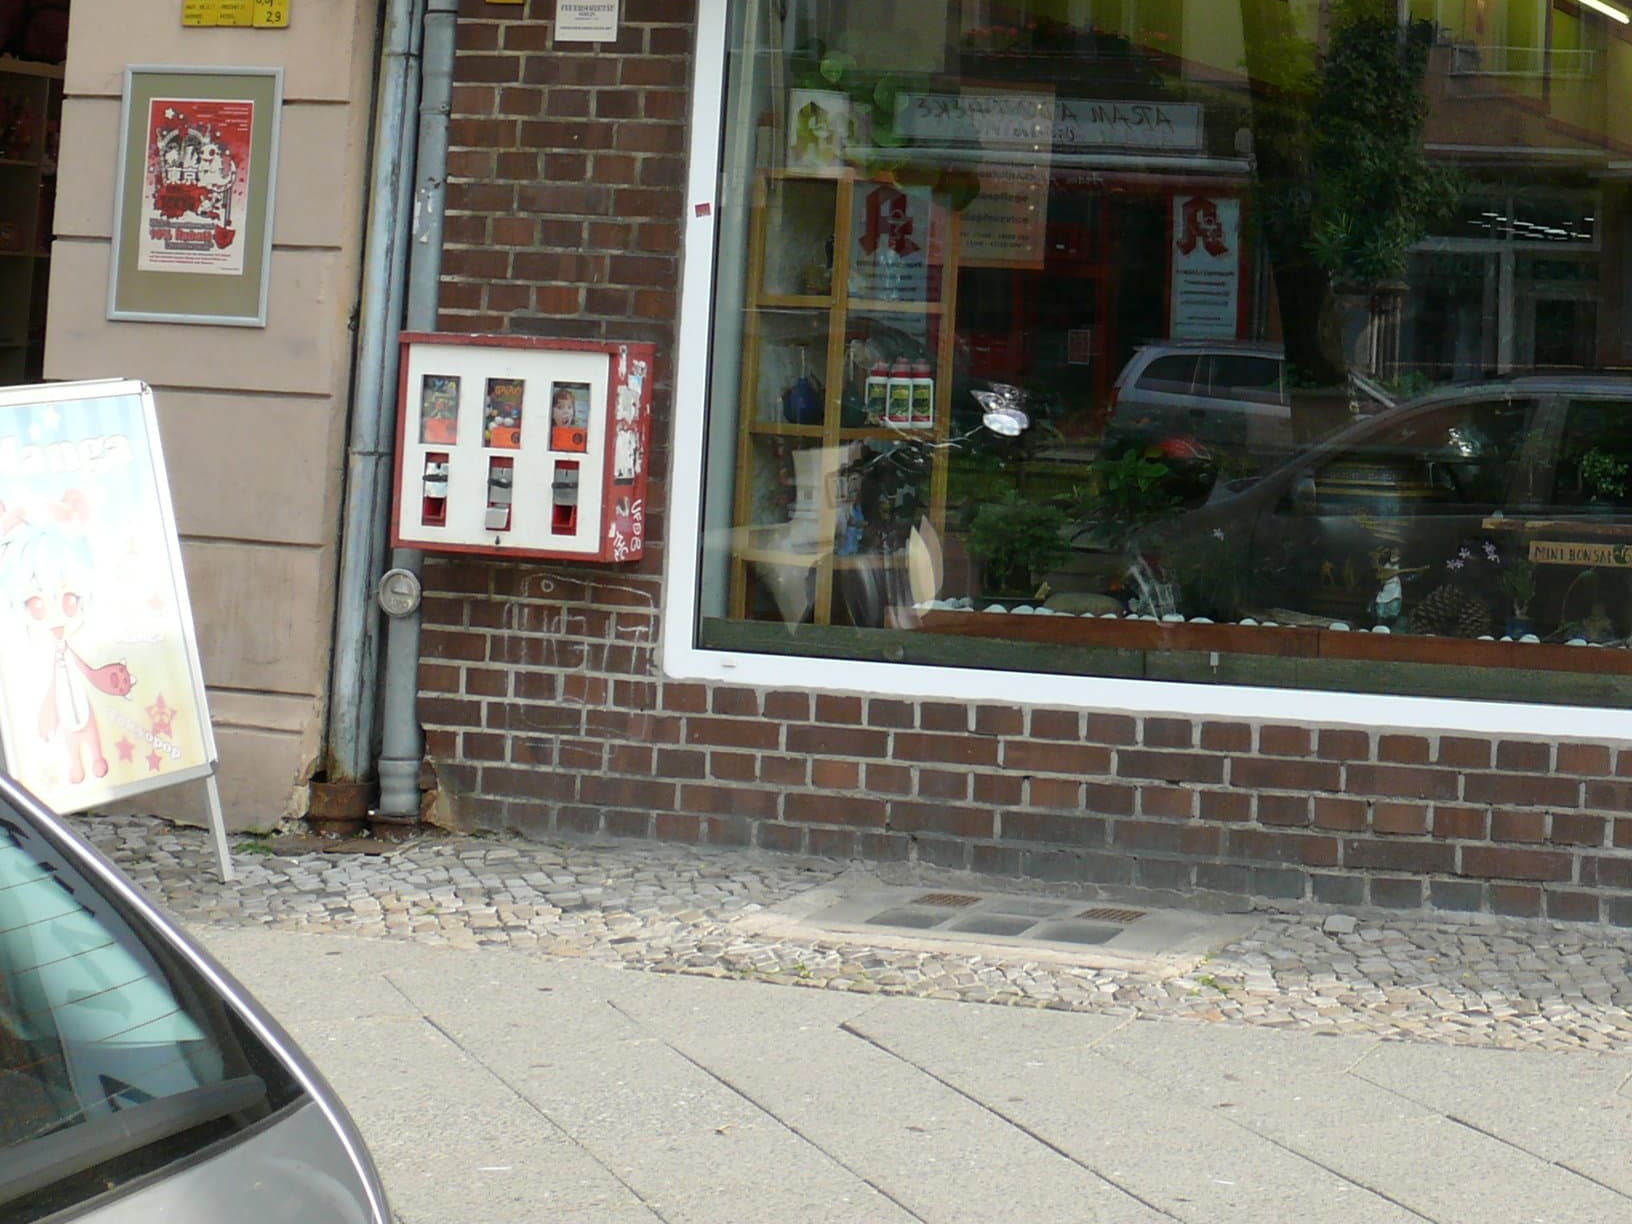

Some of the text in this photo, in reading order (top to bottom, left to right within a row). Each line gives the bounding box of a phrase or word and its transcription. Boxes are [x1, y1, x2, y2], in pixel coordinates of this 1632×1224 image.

[266, 11, 281, 24] 2,9
[1535, 545, 1611, 564] MINI BONSAI
